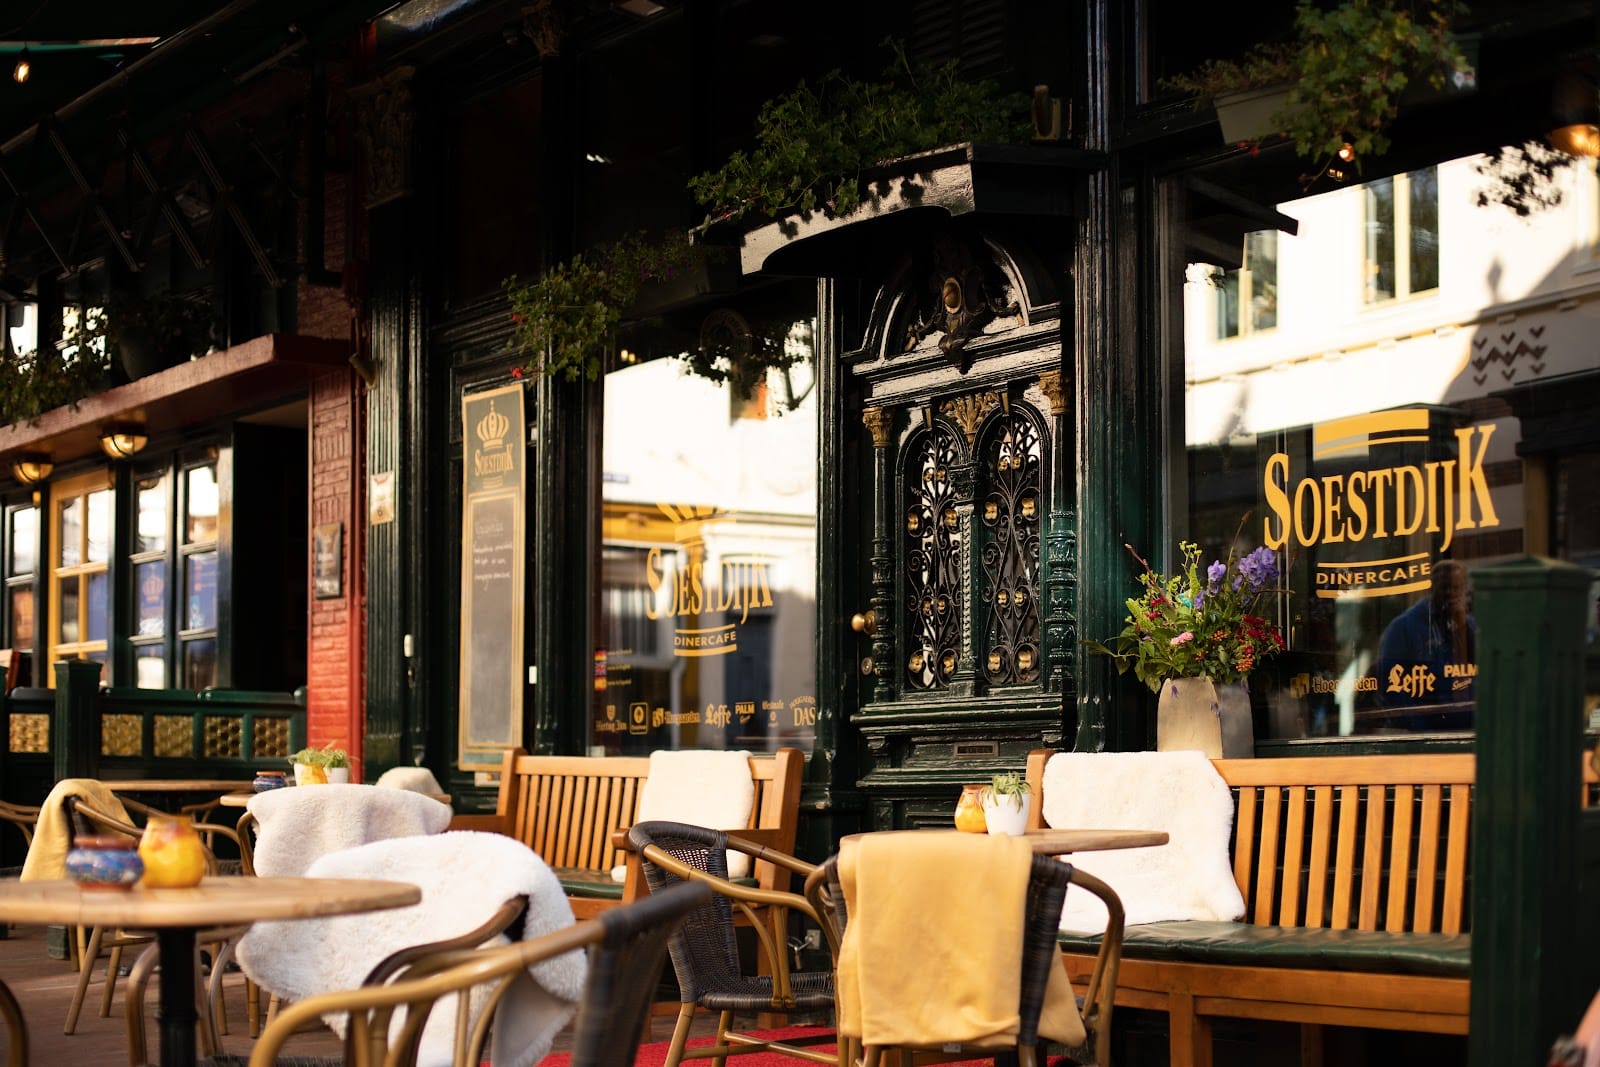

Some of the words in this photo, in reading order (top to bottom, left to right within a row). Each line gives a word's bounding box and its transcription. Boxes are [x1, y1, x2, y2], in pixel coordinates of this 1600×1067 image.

[1263, 424, 1499, 553] SOESTDIJK
[1316, 561, 1432, 586] DINERCAFE
[673, 631, 737, 647] DINERCAFE
[1386, 663, 1437, 698] Leffe
[1443, 663, 1478, 678] PALM
[1312, 676, 1378, 694] Hoegden
[704, 703, 732, 729] Leffe
[735, 703, 755, 715] PALM
